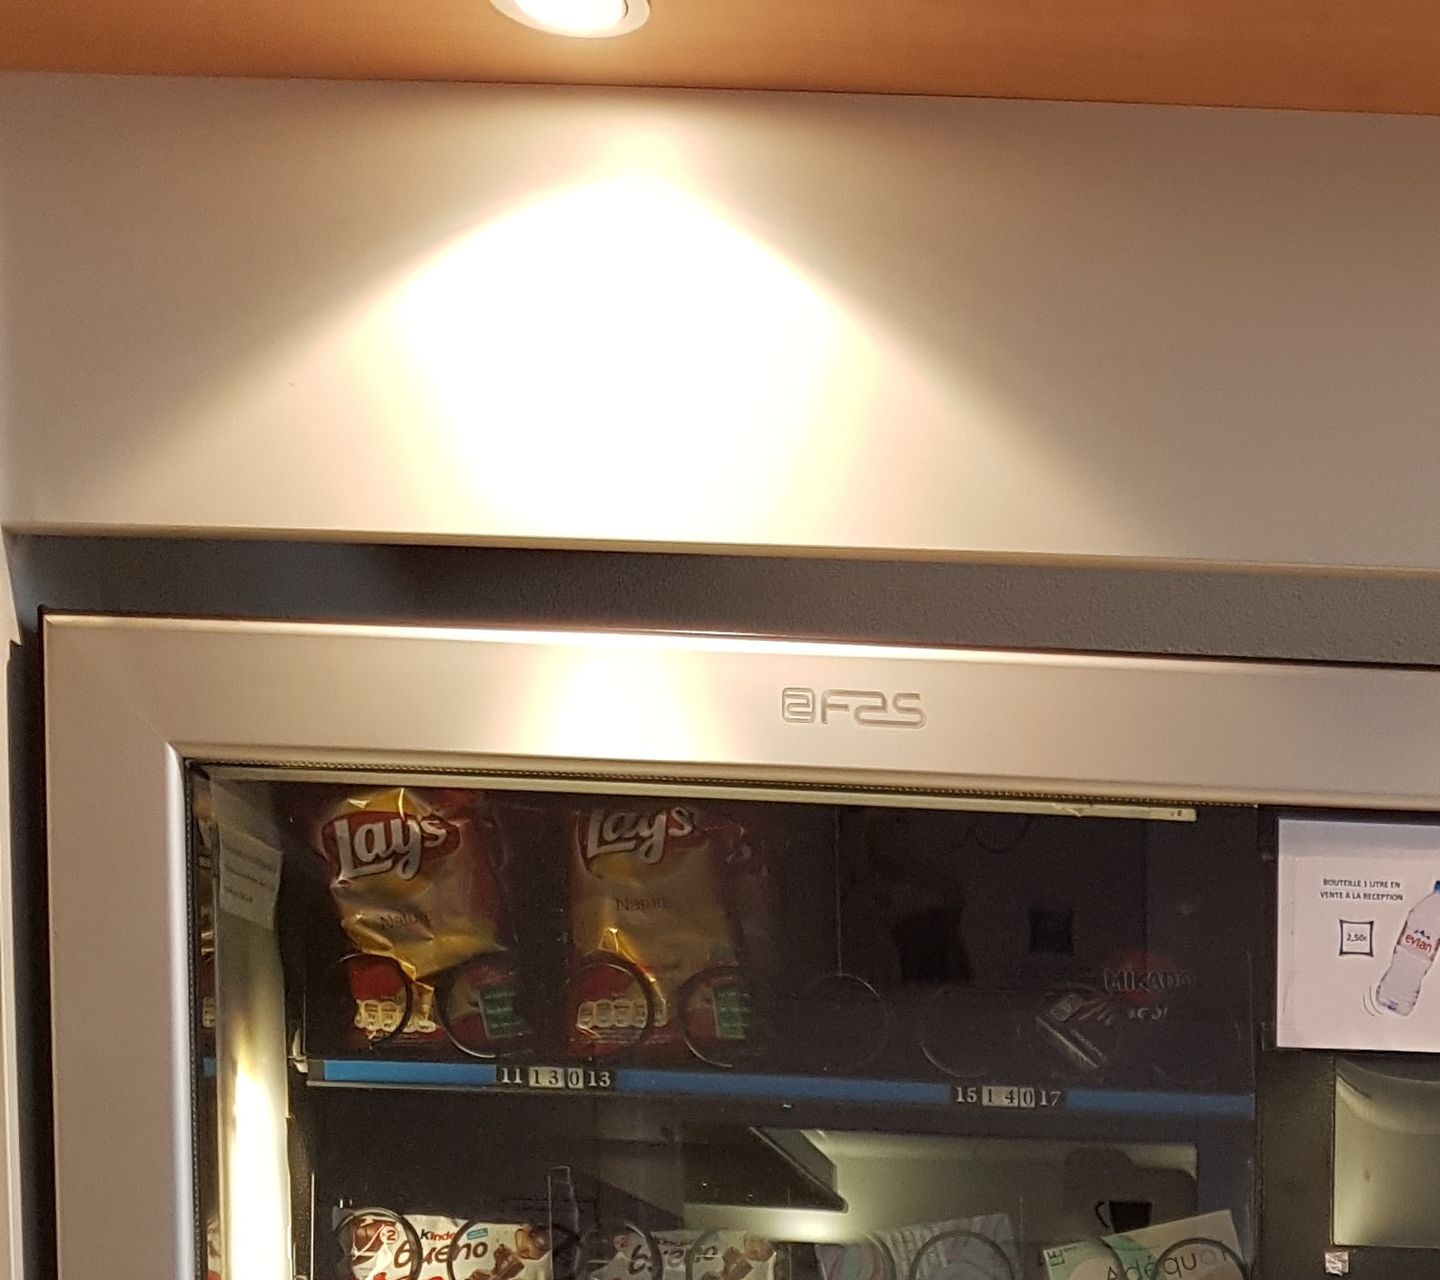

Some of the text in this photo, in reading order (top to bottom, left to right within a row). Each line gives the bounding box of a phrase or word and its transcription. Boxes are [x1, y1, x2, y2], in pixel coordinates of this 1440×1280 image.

[1405, 934, 1432, 952] evian
[501, 1068, 523, 1084] 11
[588, 1071, 611, 1088] 13
[956, 1087, 977, 1103] 15
[1040, 1090, 1062, 1106] 17
